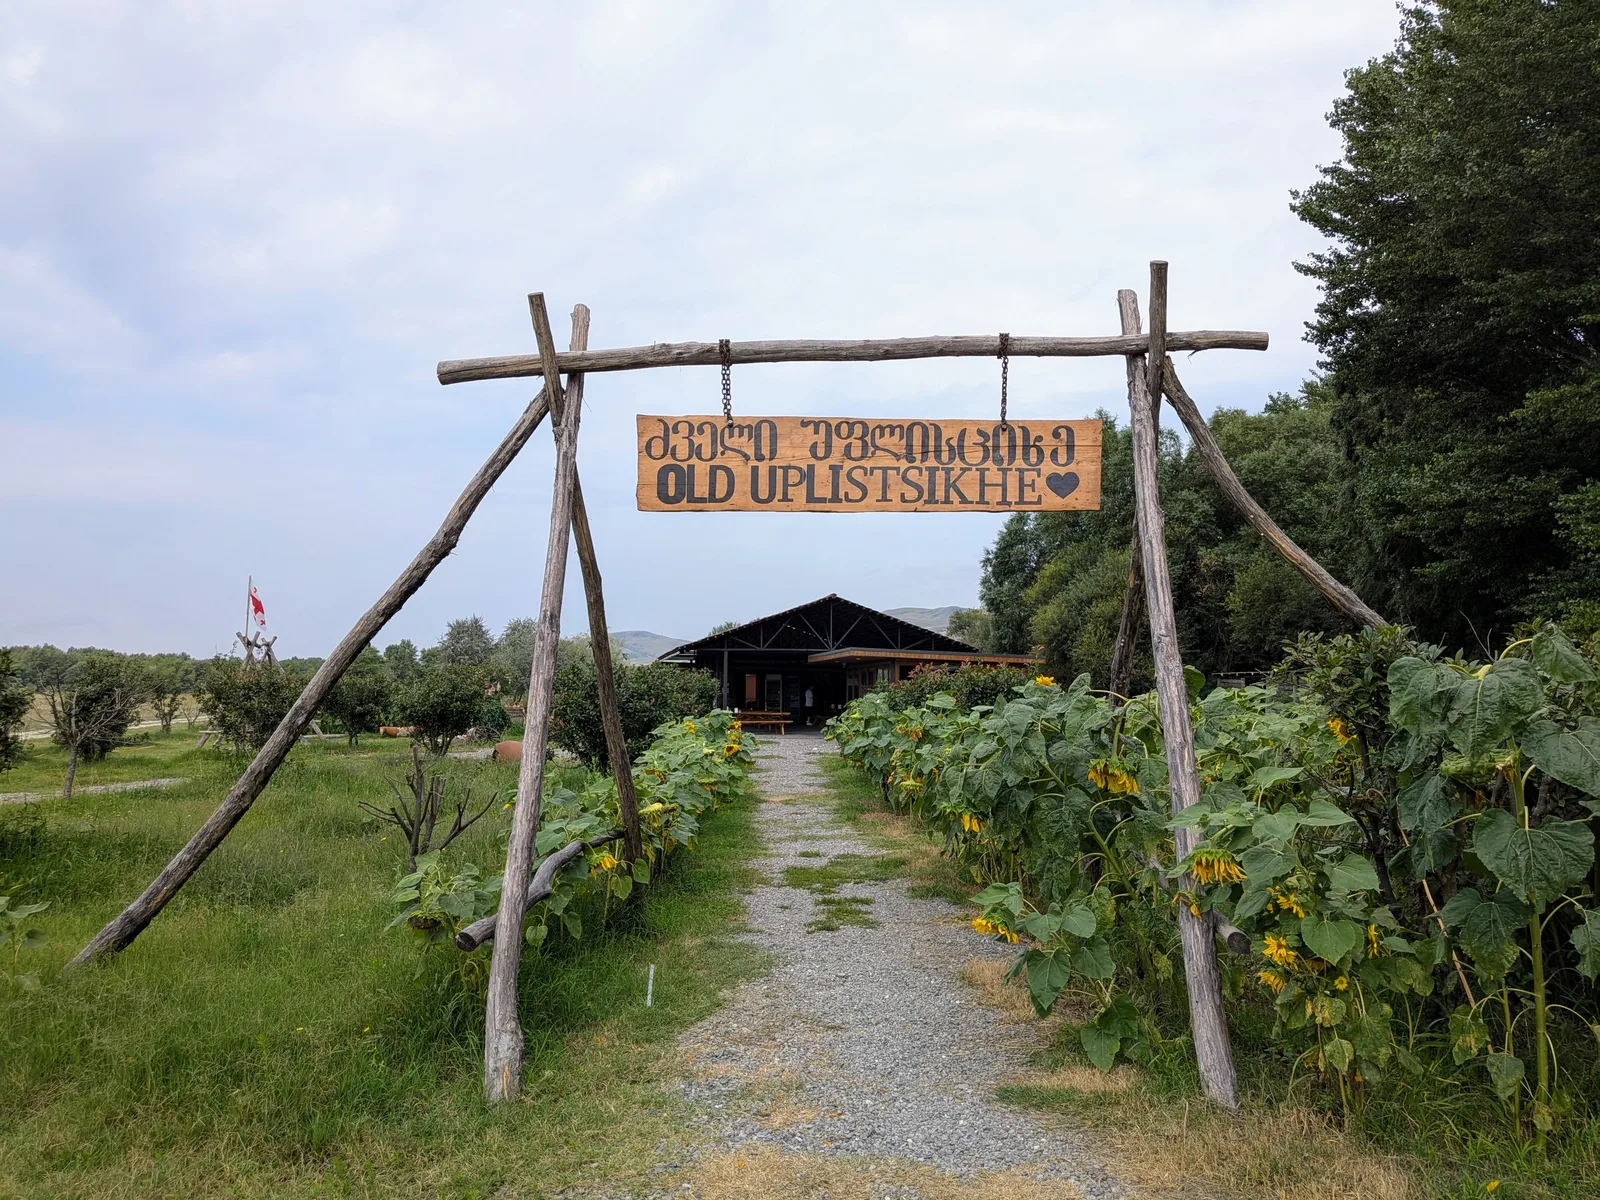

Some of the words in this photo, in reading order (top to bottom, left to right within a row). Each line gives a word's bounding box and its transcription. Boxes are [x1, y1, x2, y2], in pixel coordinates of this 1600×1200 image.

[645, 419, 777, 463] ძველი
[800, 419, 1076, 467] უფლისციხე
[657, 464, 735, 505] OLD
[751, 464, 1042, 506] UPLISTSIKHE
